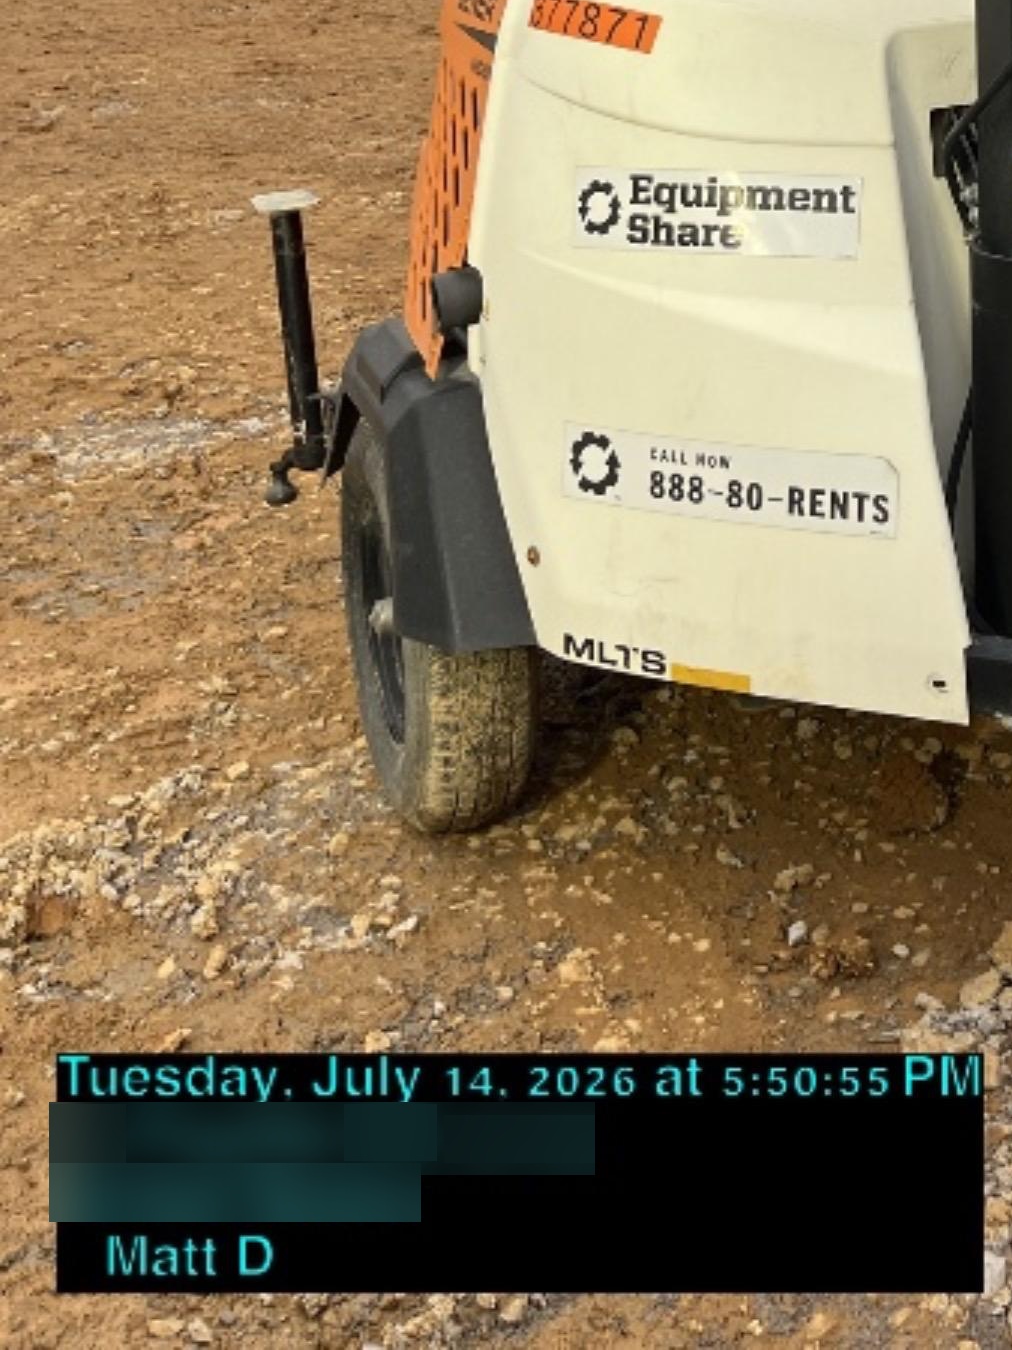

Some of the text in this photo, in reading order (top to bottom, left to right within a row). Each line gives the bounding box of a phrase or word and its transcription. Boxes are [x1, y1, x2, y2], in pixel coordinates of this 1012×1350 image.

[628, 173, 857, 216] Equipment
[626, 212, 743, 249] Share
[649, 470, 890, 524] 888-80-RENTS
[563, 632, 667, 675] MLTS
